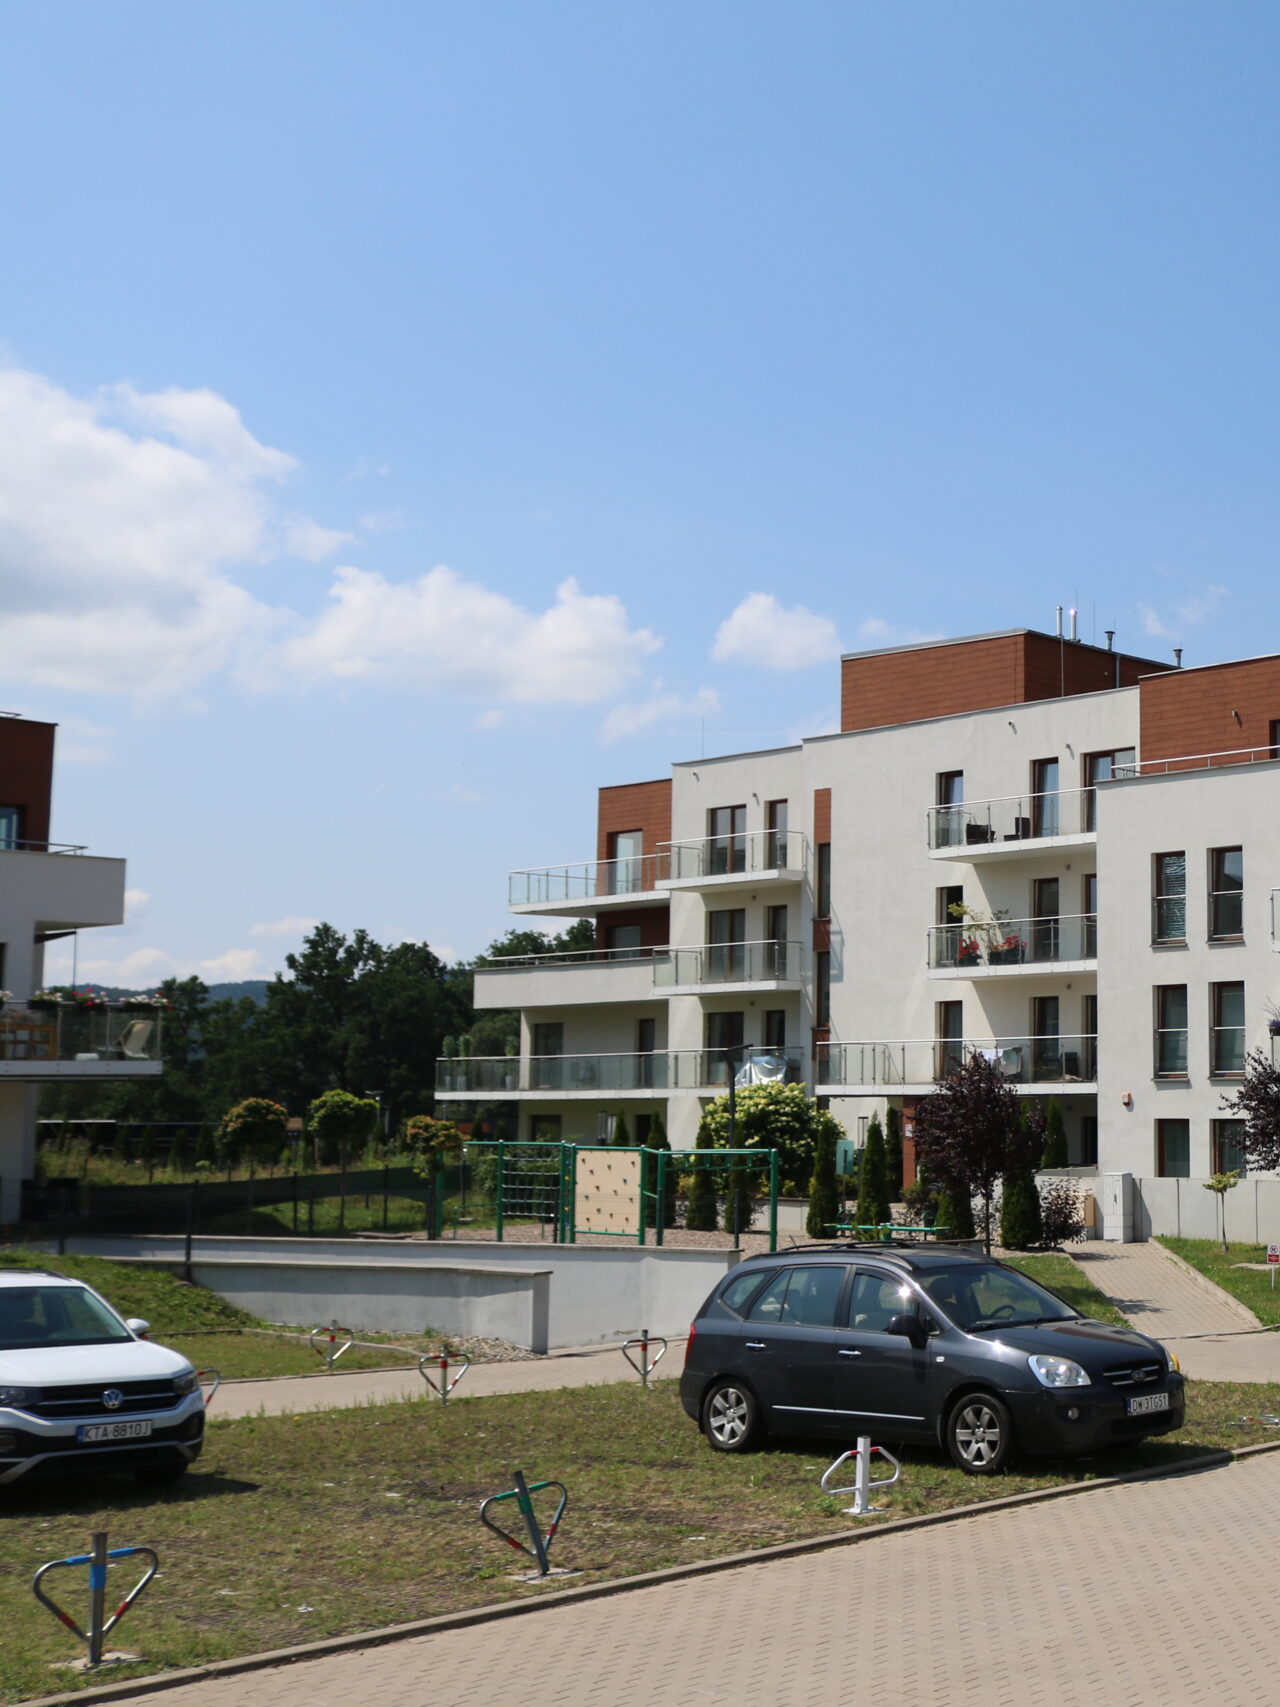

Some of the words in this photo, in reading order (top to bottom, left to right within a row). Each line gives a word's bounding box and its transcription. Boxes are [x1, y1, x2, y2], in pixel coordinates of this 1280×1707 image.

[1132, 1399, 1143, 1412] DW
[84, 1426, 109, 1439] KTA
[112, 1422, 149, 1437] 8810J
